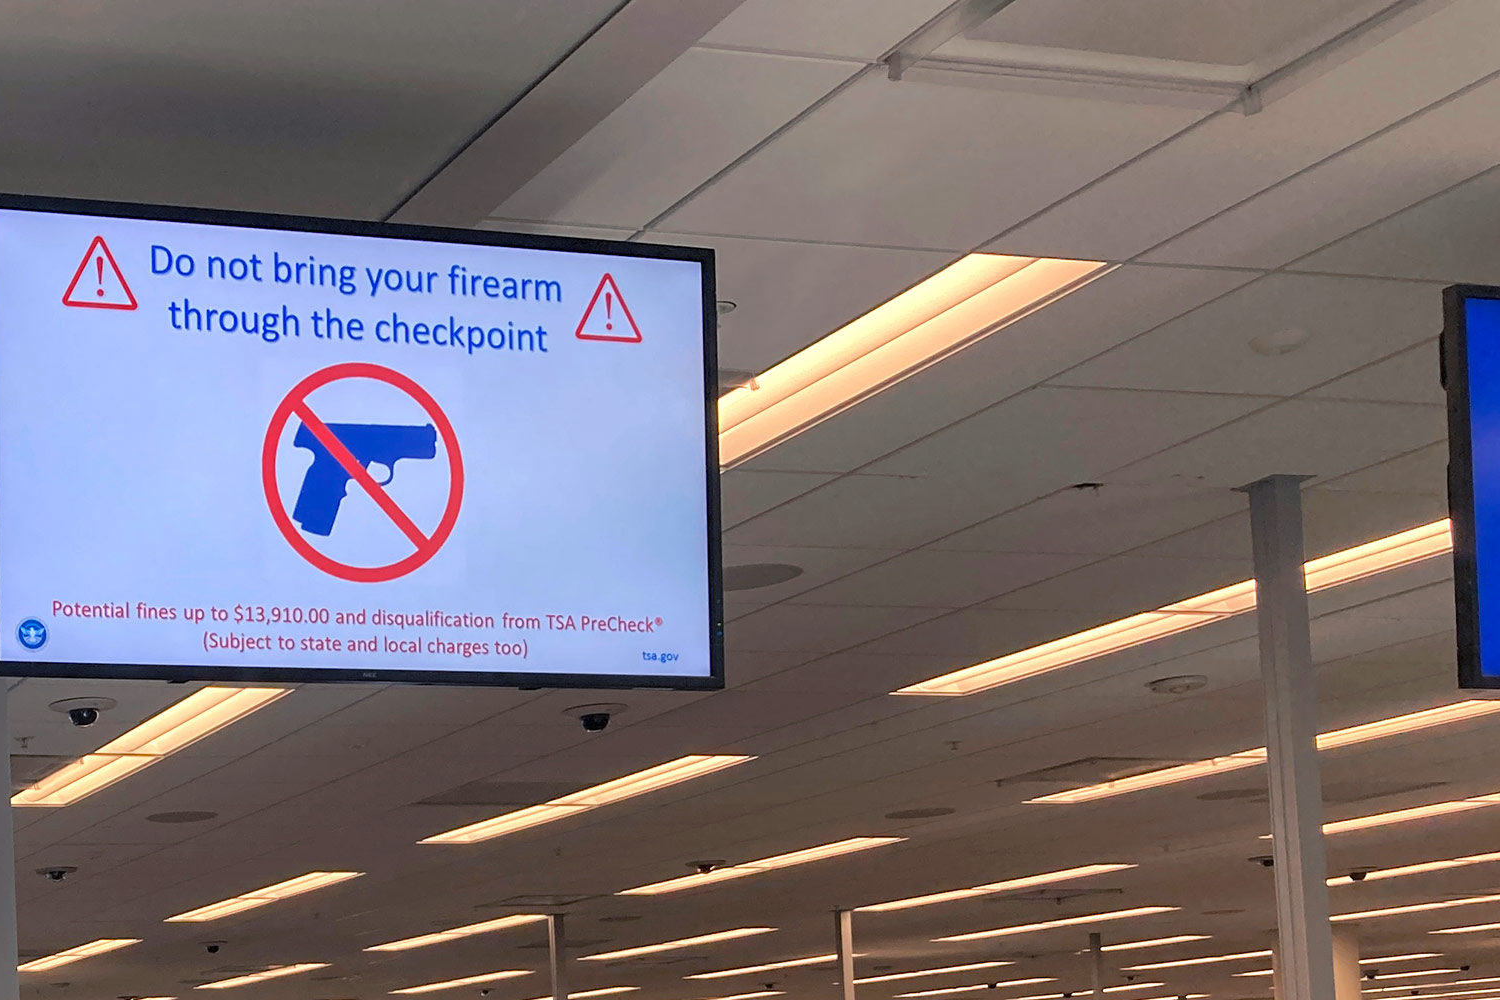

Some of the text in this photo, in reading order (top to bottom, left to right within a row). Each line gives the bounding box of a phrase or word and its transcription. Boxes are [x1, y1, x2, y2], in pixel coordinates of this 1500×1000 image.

[150, 244, 563, 303] Do not bring your firearm
[167, 297, 549, 356] through the checkpoint
[52, 600, 130, 619] Potential
[136, 602, 177, 620] fines
[183, 608, 206, 624] up
[211, 607, 229, 622] to
[233, 604, 330, 625] $13,910.00
[335, 609, 367, 625] and
[372, 609, 495, 628] disqualification
[502, 612, 541, 629] from
[546, 614, 576, 630] TSA
[203, 631, 528, 659] (Subject to state and local charges too)
[642, 651, 679, 664] tsa.gov
